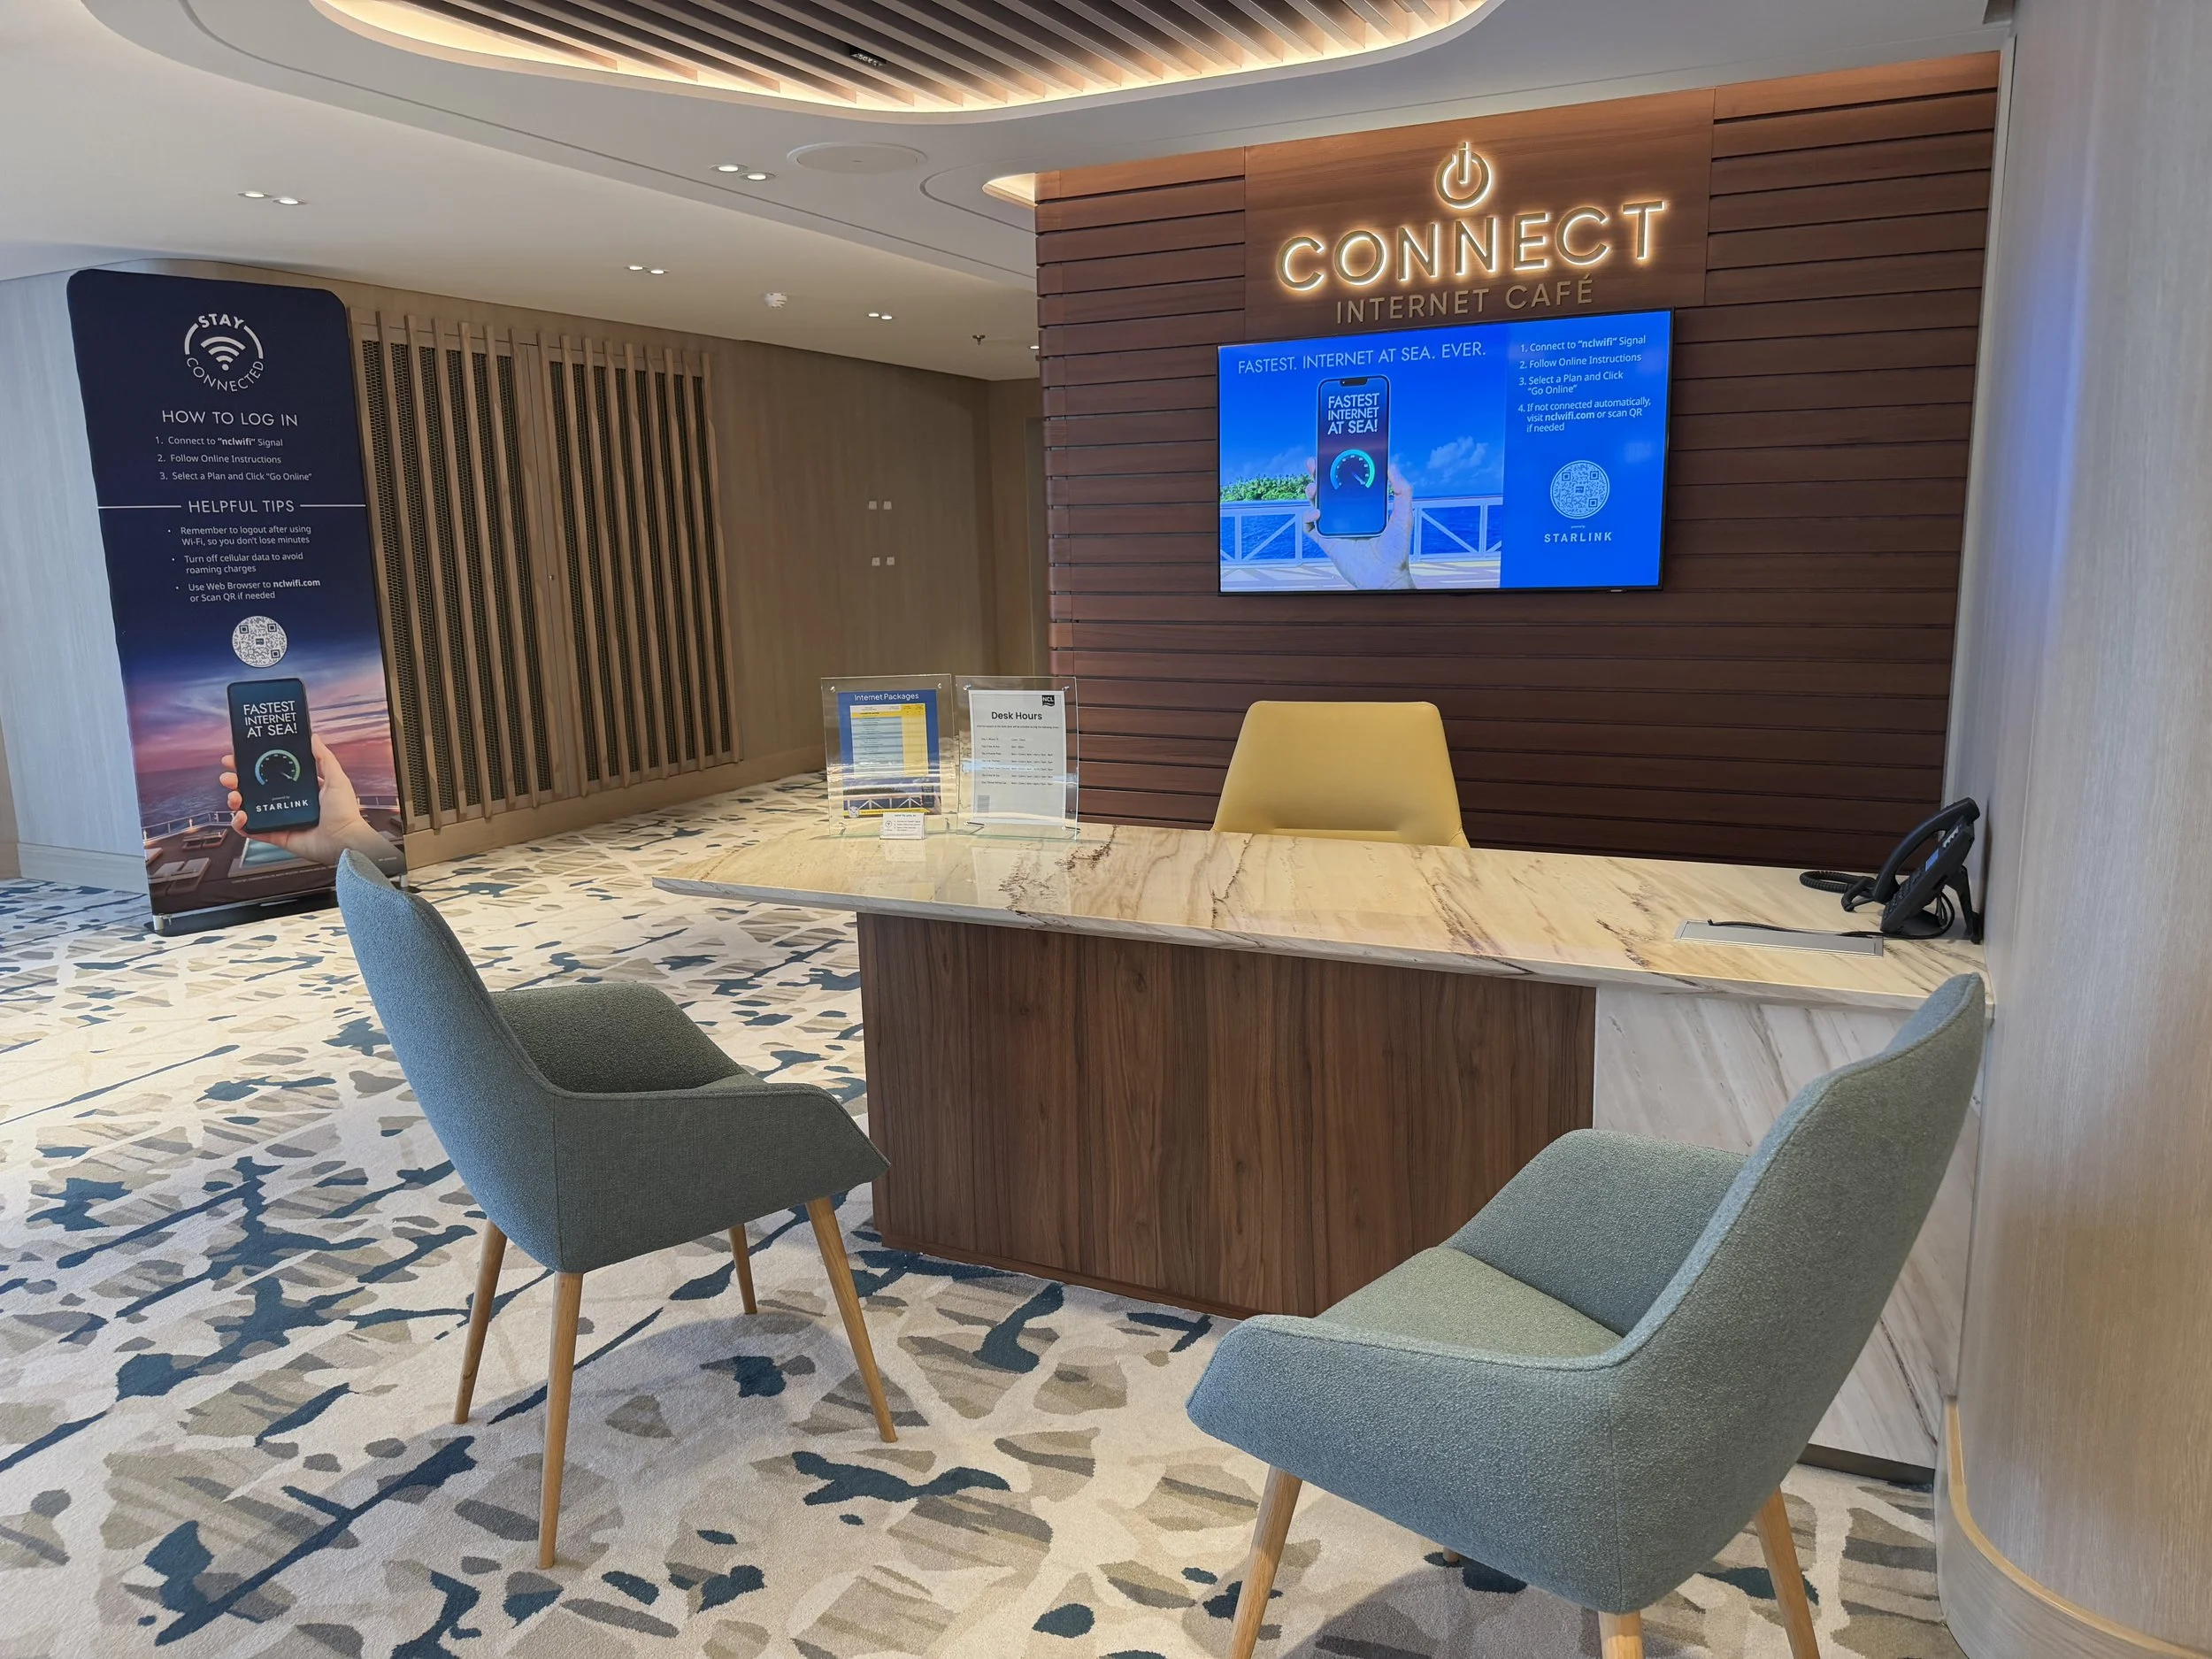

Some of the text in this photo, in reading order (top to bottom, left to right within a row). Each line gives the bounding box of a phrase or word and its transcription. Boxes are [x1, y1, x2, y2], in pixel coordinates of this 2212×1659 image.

[1276, 200, 1668, 293] CONNECT
[1336, 273, 1594, 324] INTERNET CAFÉ
[198, 313, 245, 329] STAY
[1530, 342, 1565, 352] Connect
[1578, 338, 1617, 349] "nclwifi"
[1619, 334, 1647, 348] Signal
[1239, 342, 1486, 373] FASTEST. INTERNET AT SEA. EVER.
[1529, 359, 1556, 369] Follow
[1559, 357, 1586, 366] Online
[1589, 354, 1642, 365] Instructions
[187, 357, 264, 392] CONNECTED
[1529, 375, 1554, 385] Select
[1563, 374, 1582, 383] Plan
[1584, 372, 1601, 381] and
[1603, 371, 1624, 380] Click
[1527, 385, 1577, 396] "Go Online"
[1328, 393, 1380, 409] FASTEST
[1527, 403, 1533, 412] If
[1535, 403, 1548, 411] not
[1550, 400, 1593, 411] connected
[1594, 396, 1652, 408] automatically,
[162, 411, 298, 426] HOW TO LOG IN
[1328, 407, 1380, 421] INTERNET
[1545, 411, 1594, 422] nclwifi.com
[1608, 409, 1627, 418] scan
[1629, 408, 1642, 419] QR
[1327, 419, 1378, 435] AT SEA!
[1526, 422, 1565, 433] if needed
[168, 436, 204, 445] Connect
[218, 437, 256, 446] "nclwifi"
[257, 439, 283, 449] Signal
[188, 500, 295, 513] HELPFUL TIPS
[180, 526, 227, 535] Remember
[240, 526, 267, 535] logout
[289, 526, 311, 534] using
[1544, 532, 1612, 543] STARLINK
[182, 538, 205, 547] Wi-Fi,
[219, 538, 234, 547] you
[186, 565, 257, 575] roaming charges
[206, 582, 226, 591] Web
[227, 581, 260, 590] Browser
[273, 579, 320, 588] nclwifi.com
[223, 593, 235, 602] QR
[245, 591, 275, 600] needed
[243, 700, 296, 716] FASTEST
[244, 712, 296, 726] INTERNET
[247, 722, 297, 738] AT SEA!
[256, 799, 309, 812] STARLINK
